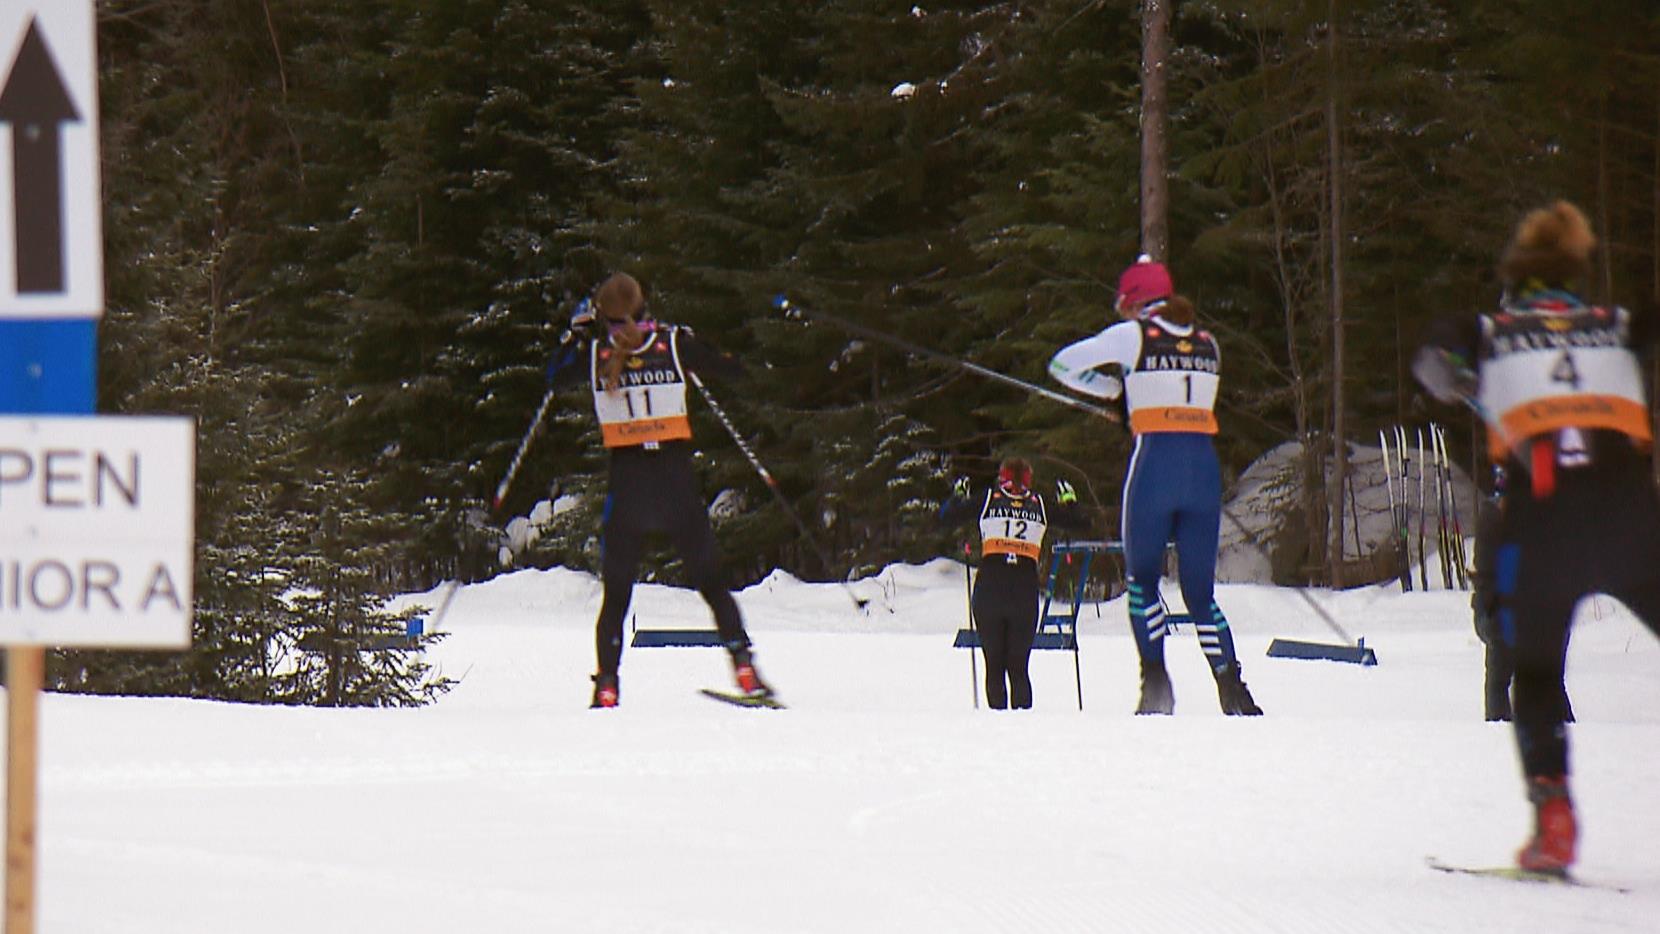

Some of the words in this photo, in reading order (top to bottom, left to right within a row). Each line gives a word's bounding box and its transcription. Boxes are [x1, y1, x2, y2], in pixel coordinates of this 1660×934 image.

[598, 370, 676, 387] YWOOD
[1552, 349, 1580, 390] 4
[624, 388, 653, 419] 11
[1184, 374, 1193, 405] 1
[989, 507, 1042, 522] HAYWOOD
[1004, 520, 1028, 540] 12
[0, 559, 121, 612] IOR
[141, 561, 181, 612] A
